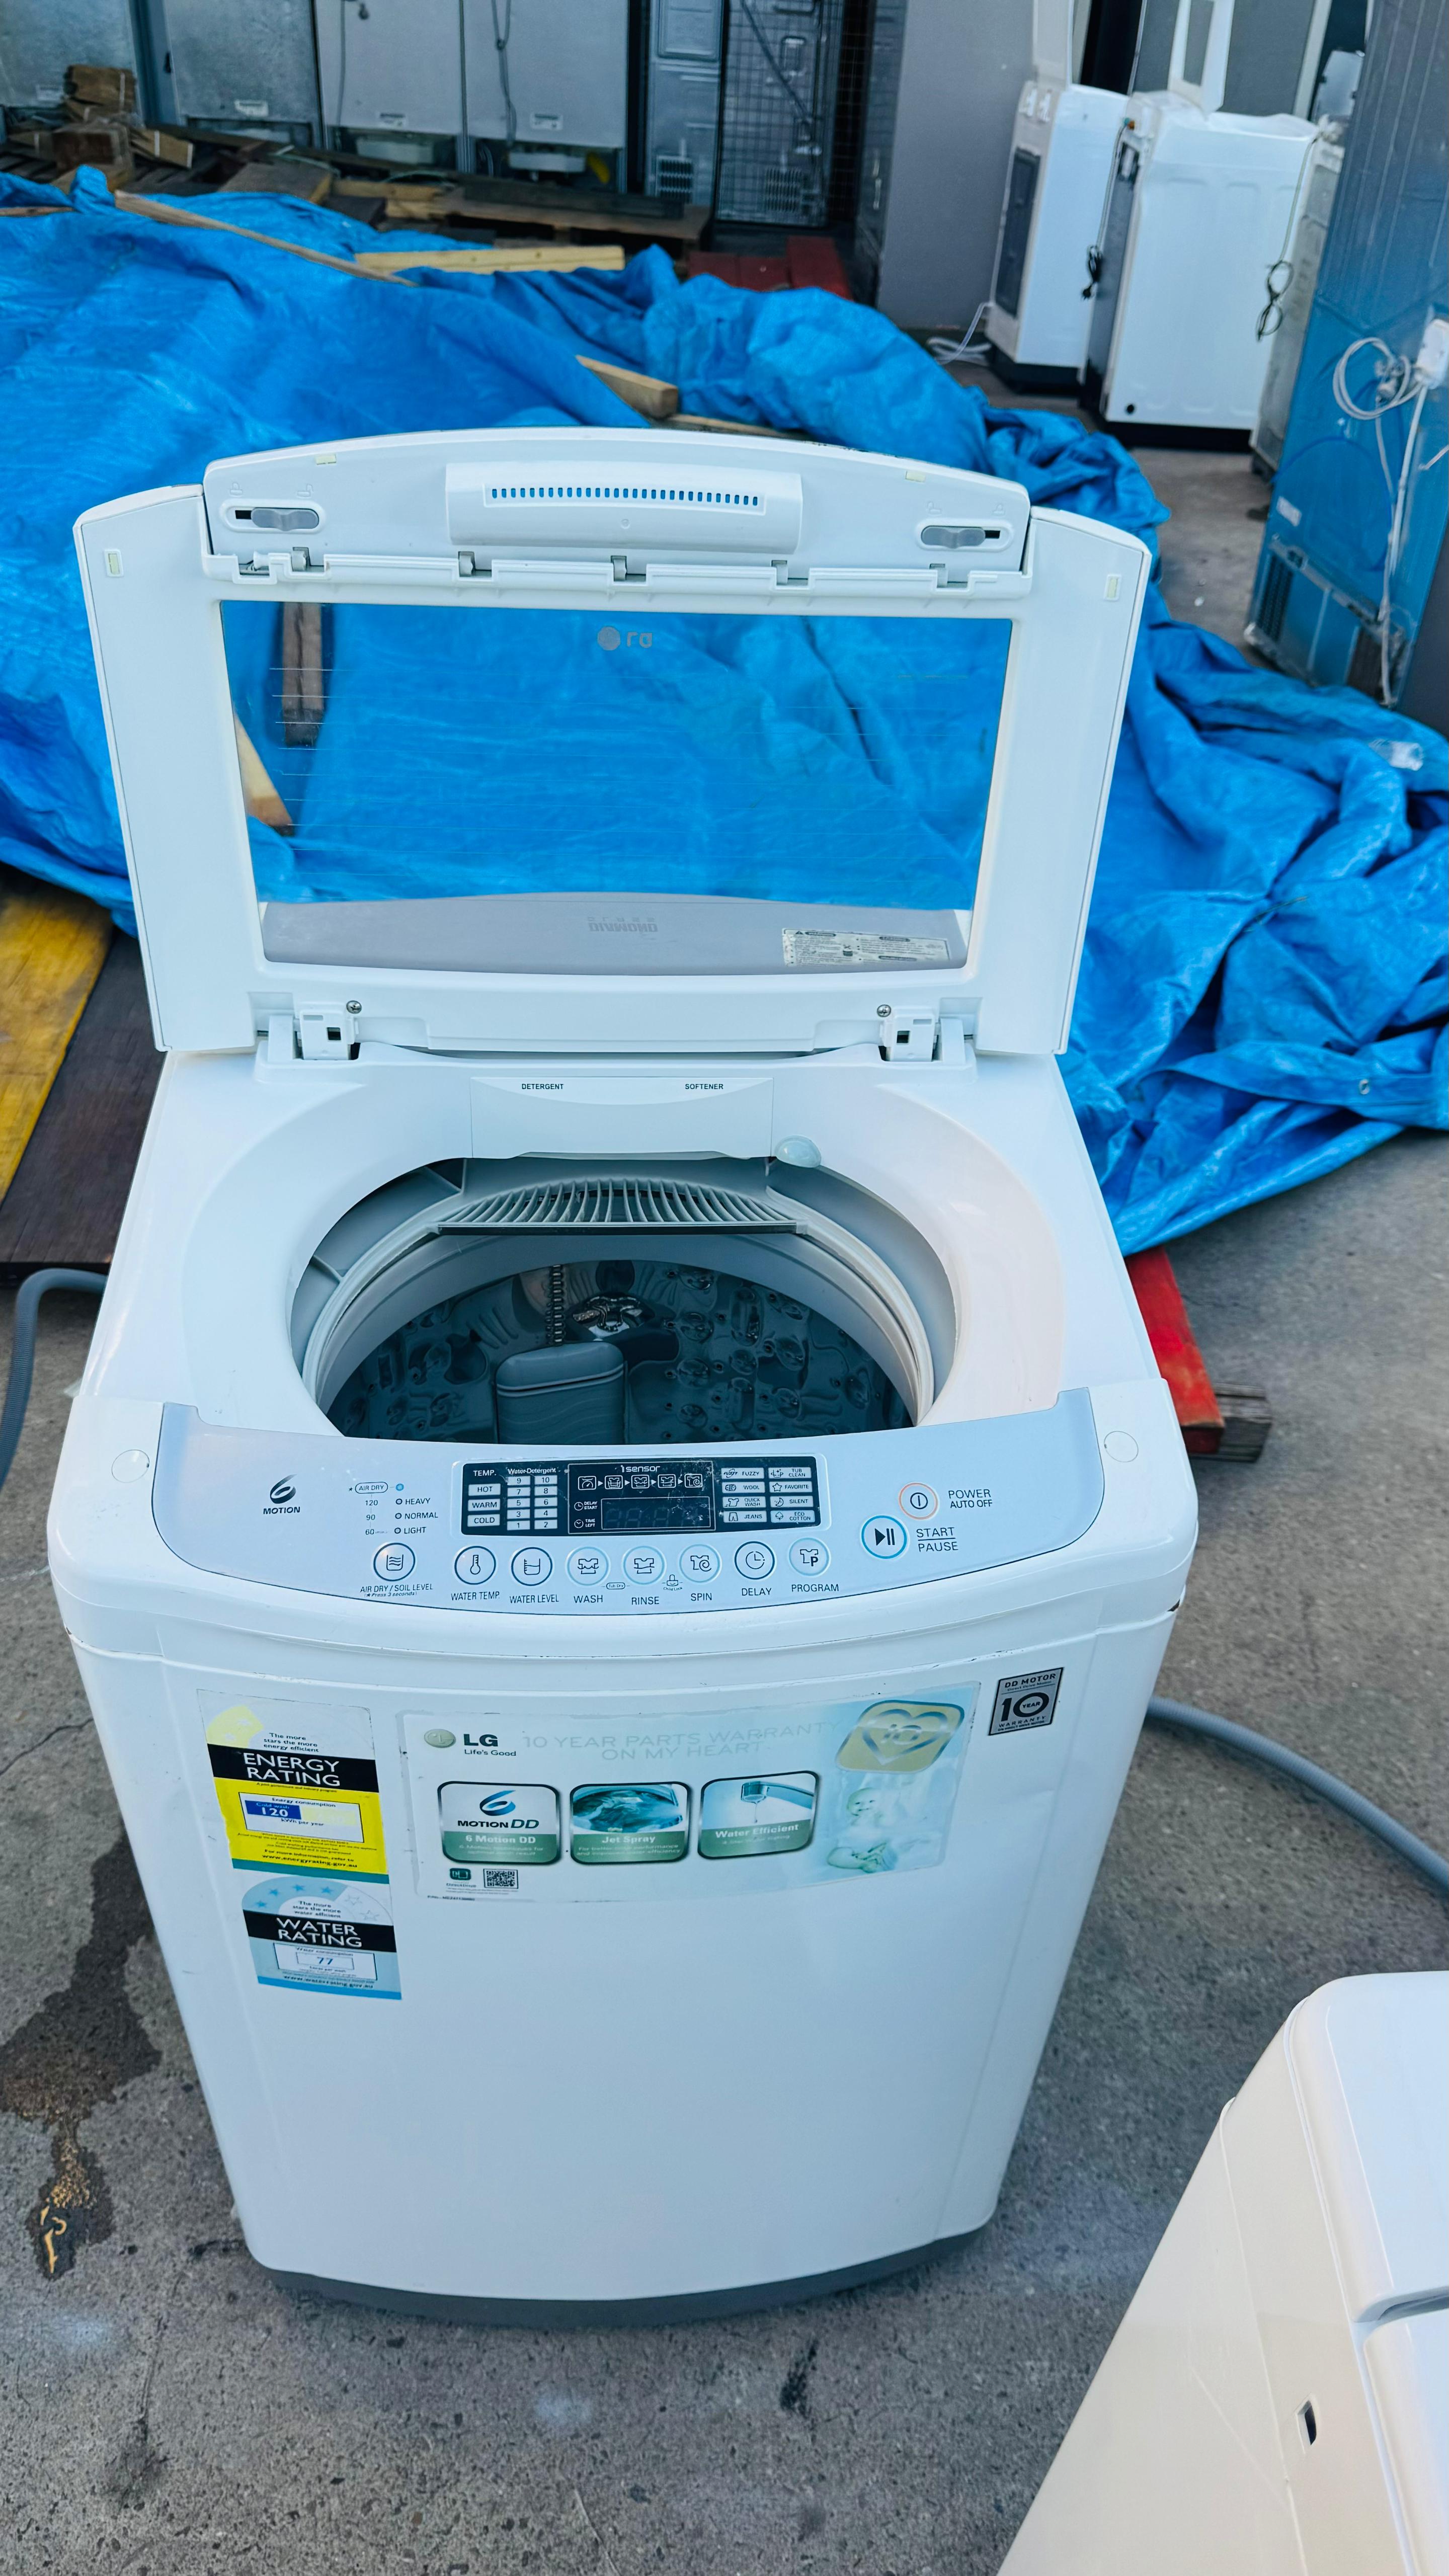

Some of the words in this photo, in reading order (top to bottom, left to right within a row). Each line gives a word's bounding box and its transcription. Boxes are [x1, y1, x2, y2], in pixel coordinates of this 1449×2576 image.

[948, 1489, 991, 1499] POWER
[950, 1500, 975, 1508] AUTO
[977, 1499, 993, 1507] OFF
[263, 1506, 301, 1515] MOTION
[916, 1527, 955, 1538] START
[918, 1542, 958, 1552] PAUSE
[741, 1587, 772, 1596] DELAY
[791, 1583, 840, 1592] PROGRAM
[451, 1591, 476, 1601] WATER
[509, 1595, 536, 1604] WATER
[537, 1594, 559, 1603] LEVEL
[574, 1594, 604, 1603] WASH
[631, 1596, 660, 1605] RINSE
[690, 1592, 712, 1601] SPIN
[1005, 1680, 1018, 1688] DD
[1021, 1673, 1057, 1685] MOTOR
[1001, 1692, 1050, 1722] 10
[999, 1715, 1046, 1728] WARRANTY
[523, 1737, 547, 1748] 10
[554, 1736, 617, 1748] YEAR
[625, 1733, 701, 1747] PARTS
[708, 1720, 843, 1743] WARRANTY
[463, 1733, 499, 1747] LG
[602, 1749, 636, 1760] ON
[646, 1747, 680, 1759] MY
[243, 1752, 340, 1773] ENERGY
[247, 1766, 341, 1787] RATING
[261, 1807, 289, 1817] 120
[457, 1820, 509, 1828] MOTION
[510, 1819, 539, 1829] DD
[715, 1830, 750, 1838] Water
[753, 1824, 799, 1835] Efficient
[475, 1835, 516, 1843] Motion
[519, 1836, 536, 1844] DD
[623, 1836, 656, 1844] Spray
[276, 1917, 358, 1936] WATER
[278, 1929, 362, 1948] RATING
